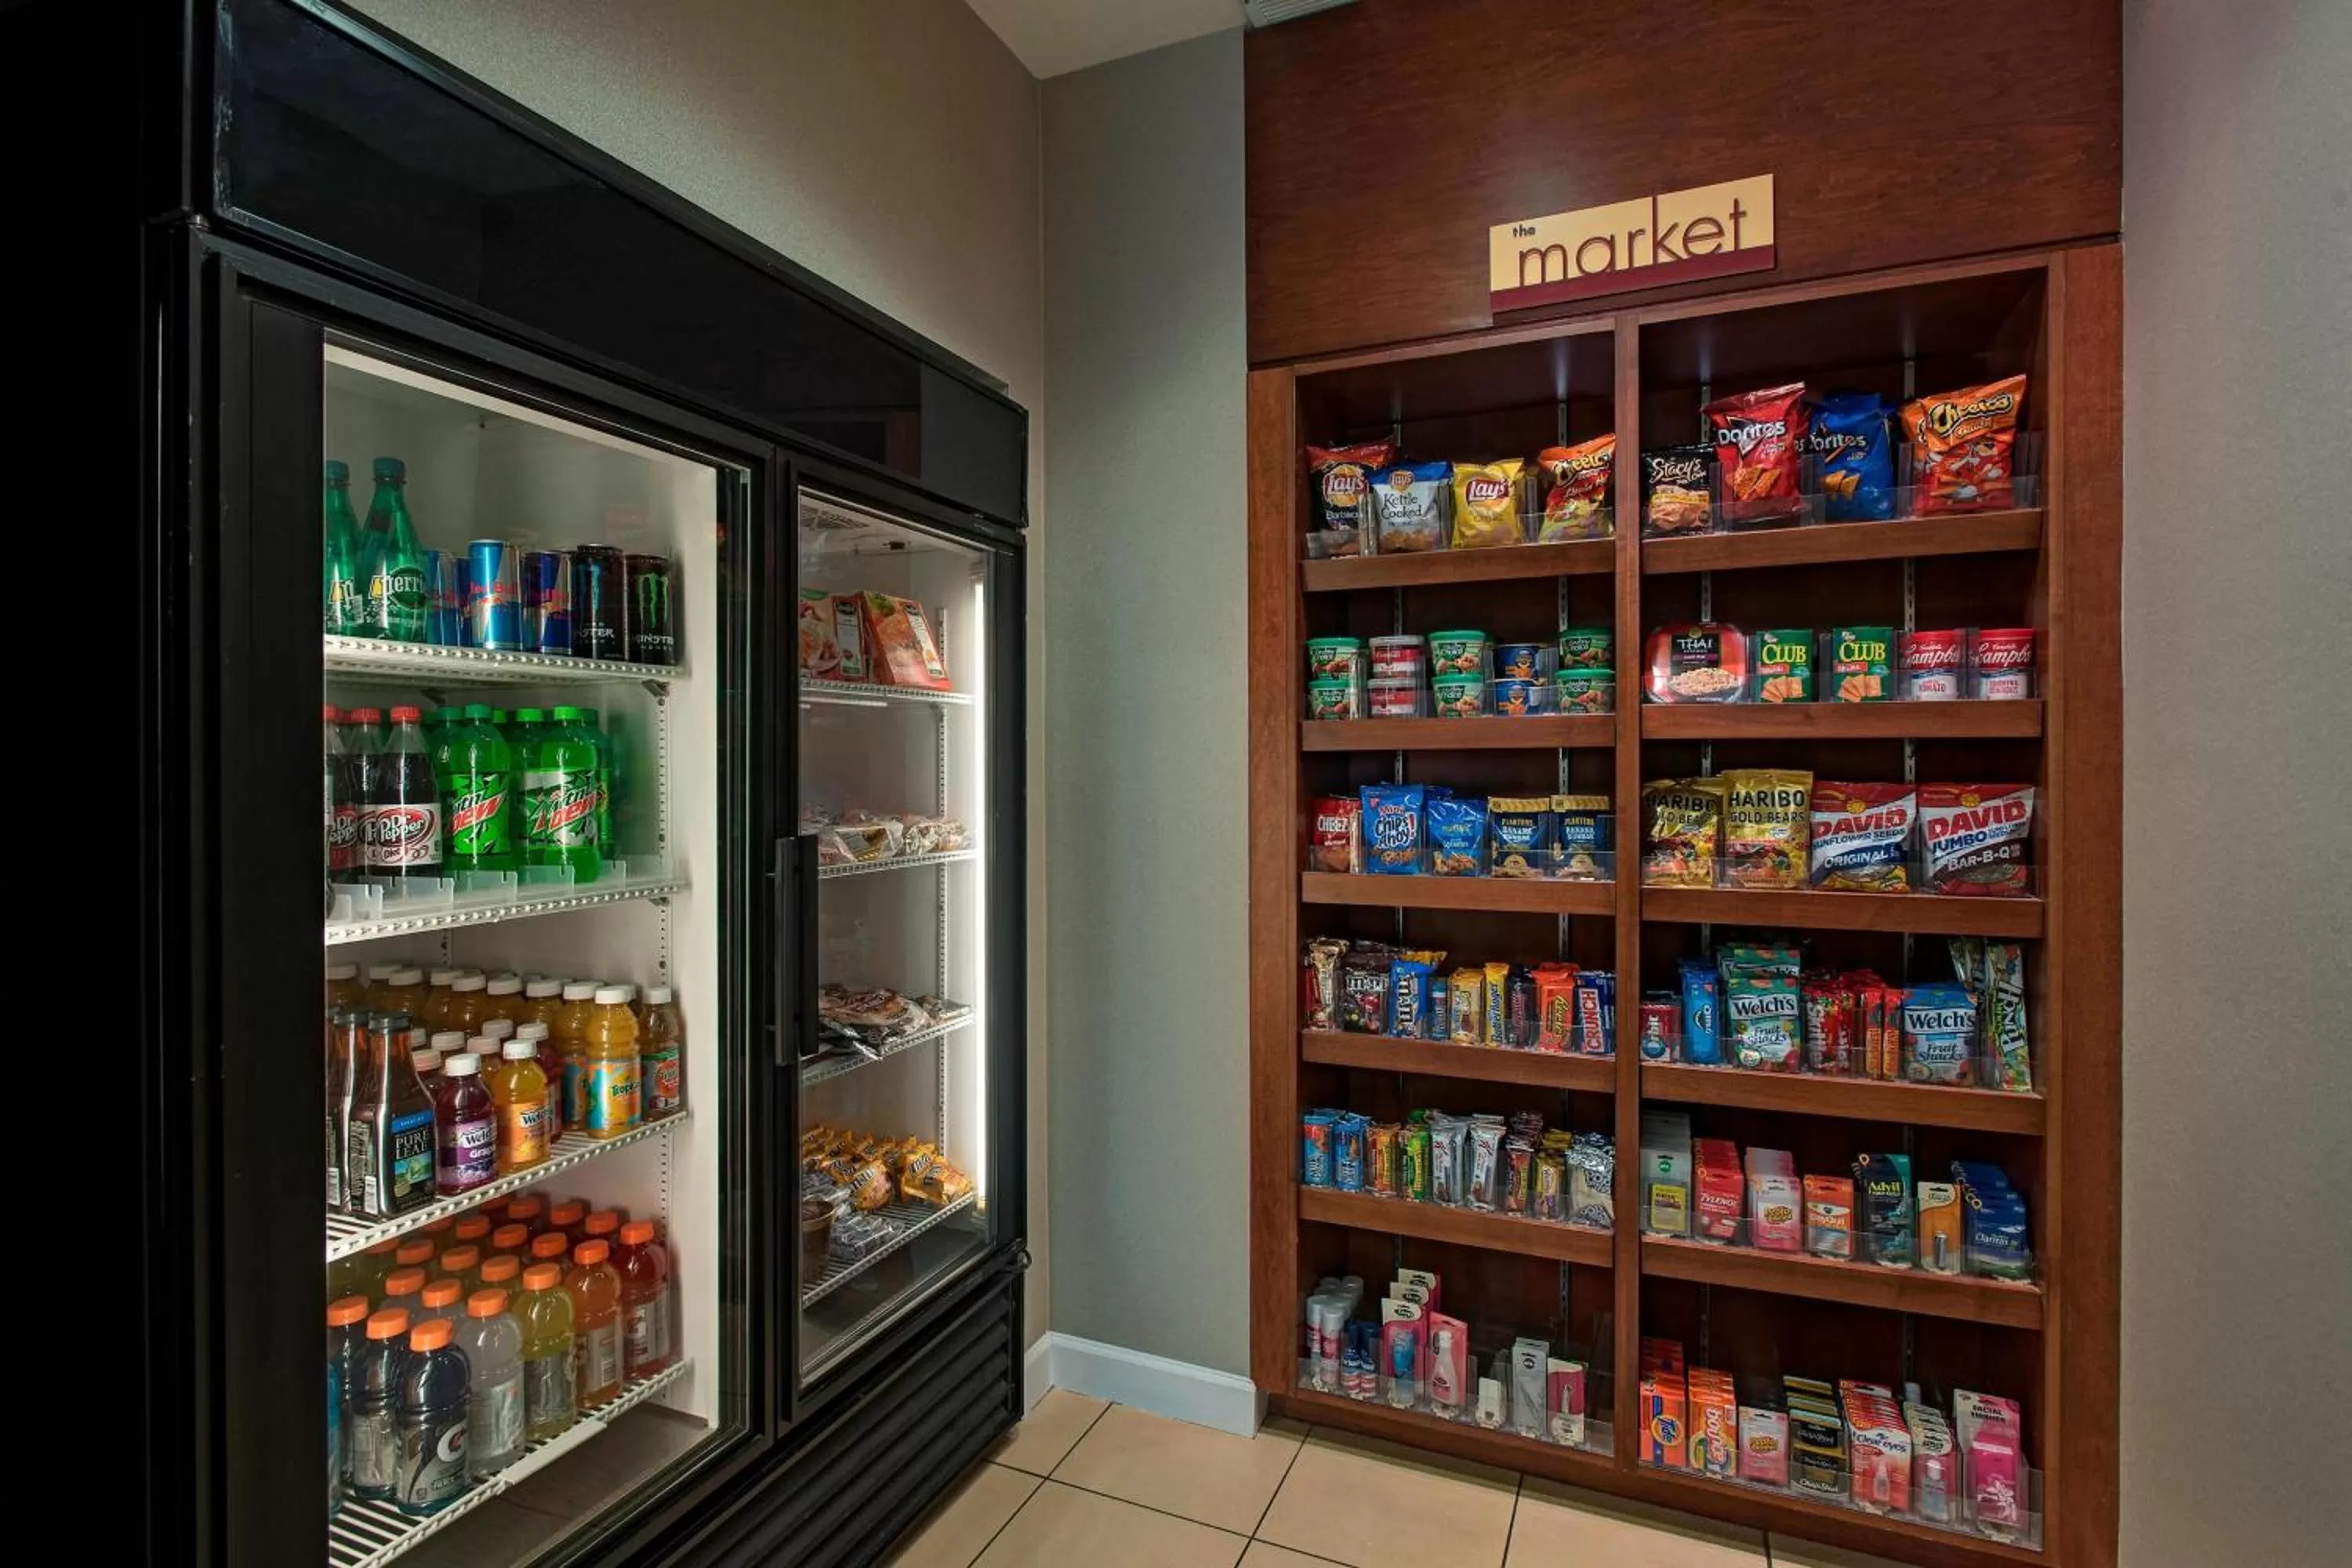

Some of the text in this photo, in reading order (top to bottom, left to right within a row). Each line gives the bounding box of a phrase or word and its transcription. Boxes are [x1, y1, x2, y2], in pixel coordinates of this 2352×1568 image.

[1512, 224, 1537, 238] the
[1519, 195, 1748, 288] market
[1718, 419, 1786, 445] Doritos
[1327, 474, 1367, 493] Lay's
[1468, 478, 1508, 502] Lay's
[1383, 493, 1418, 508] Kettle
[1381, 504, 1422, 520] Cooked
[1676, 638, 1712, 651] THAI
[1762, 644, 1807, 665] CLUB
[1838, 641, 1886, 662] CLUB
[1729, 789, 1806, 808] HARIBO
[379, 818, 424, 843] Pepper
[1811, 807, 1908, 841] DAVID
[1927, 800, 2027, 842] DAVID
[1873, 827, 1906, 839] SEEDS
[1932, 830, 1987, 854] JUMBO
[1823, 849, 1889, 869] ORIGINAL
[1947, 845, 2012, 872] BAR-B-Q
[1732, 996, 1795, 1017] Welch's
[1998, 980, 2025, 1052] PUNCH
[1582, 990, 1602, 1050] CRUNCH
[1907, 1008, 1976, 1031] Welch's
[395, 1129, 429, 1149] PURE
[1868, 1181, 1900, 1193] Advil
[1856, 1433, 1907, 1453] Clear eyes
